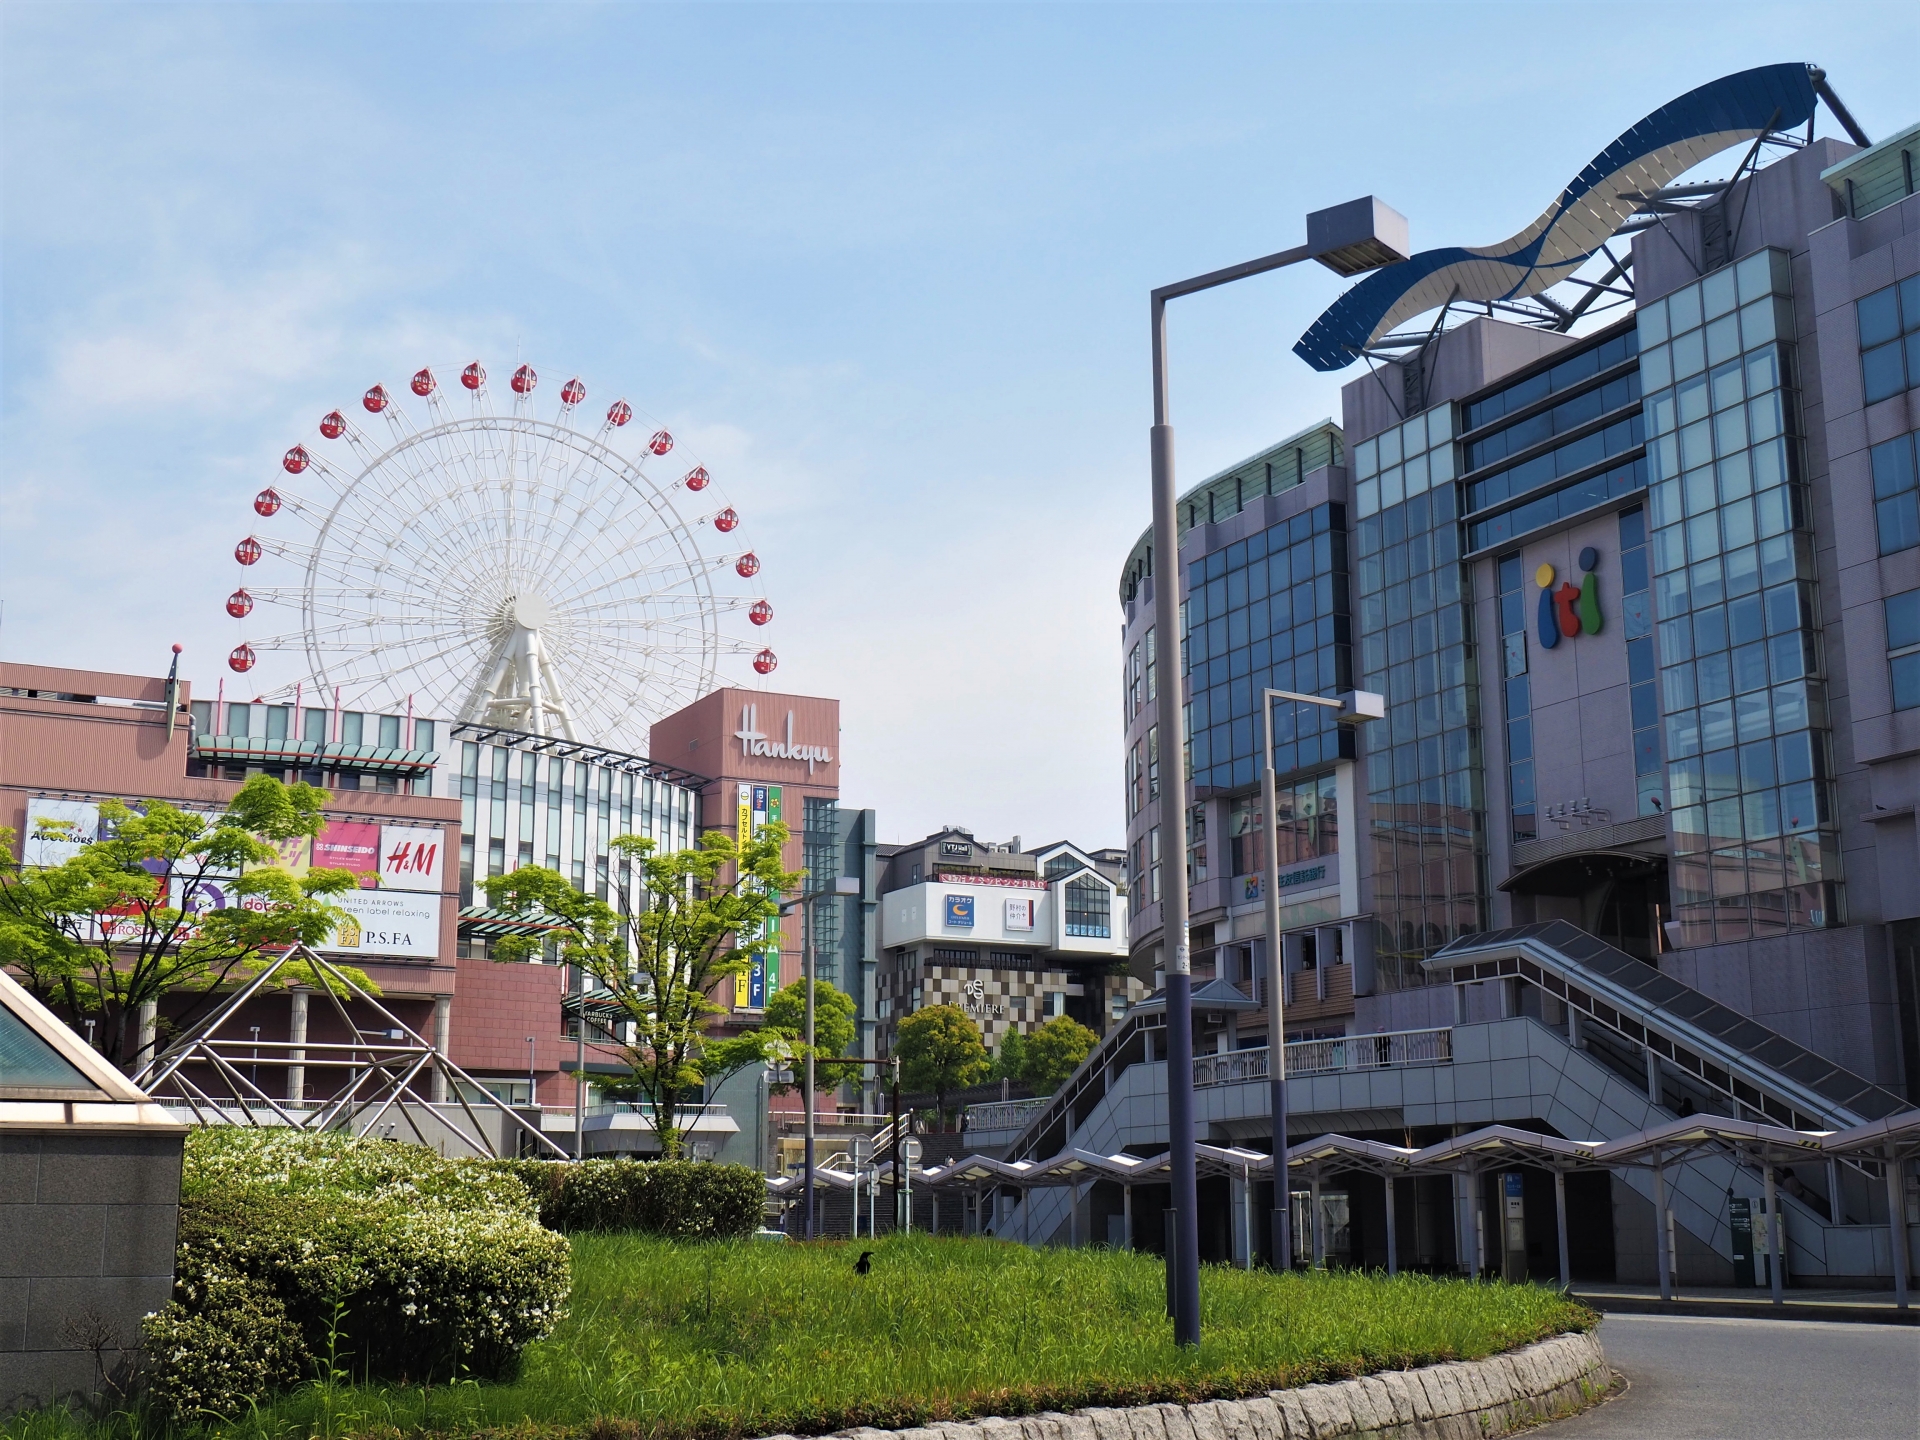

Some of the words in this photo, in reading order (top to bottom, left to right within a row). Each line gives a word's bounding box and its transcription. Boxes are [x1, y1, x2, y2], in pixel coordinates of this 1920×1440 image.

[734, 703, 833, 775] Hankyu
[324, 843, 375, 854] SHINSEIDO
[387, 841, 437, 876] H&M
[371, 899, 404, 907] ARROWS
[948, 896, 972, 904] カラオケ
[367, 908, 390, 916] label
[392, 910, 430, 919] relaxing
